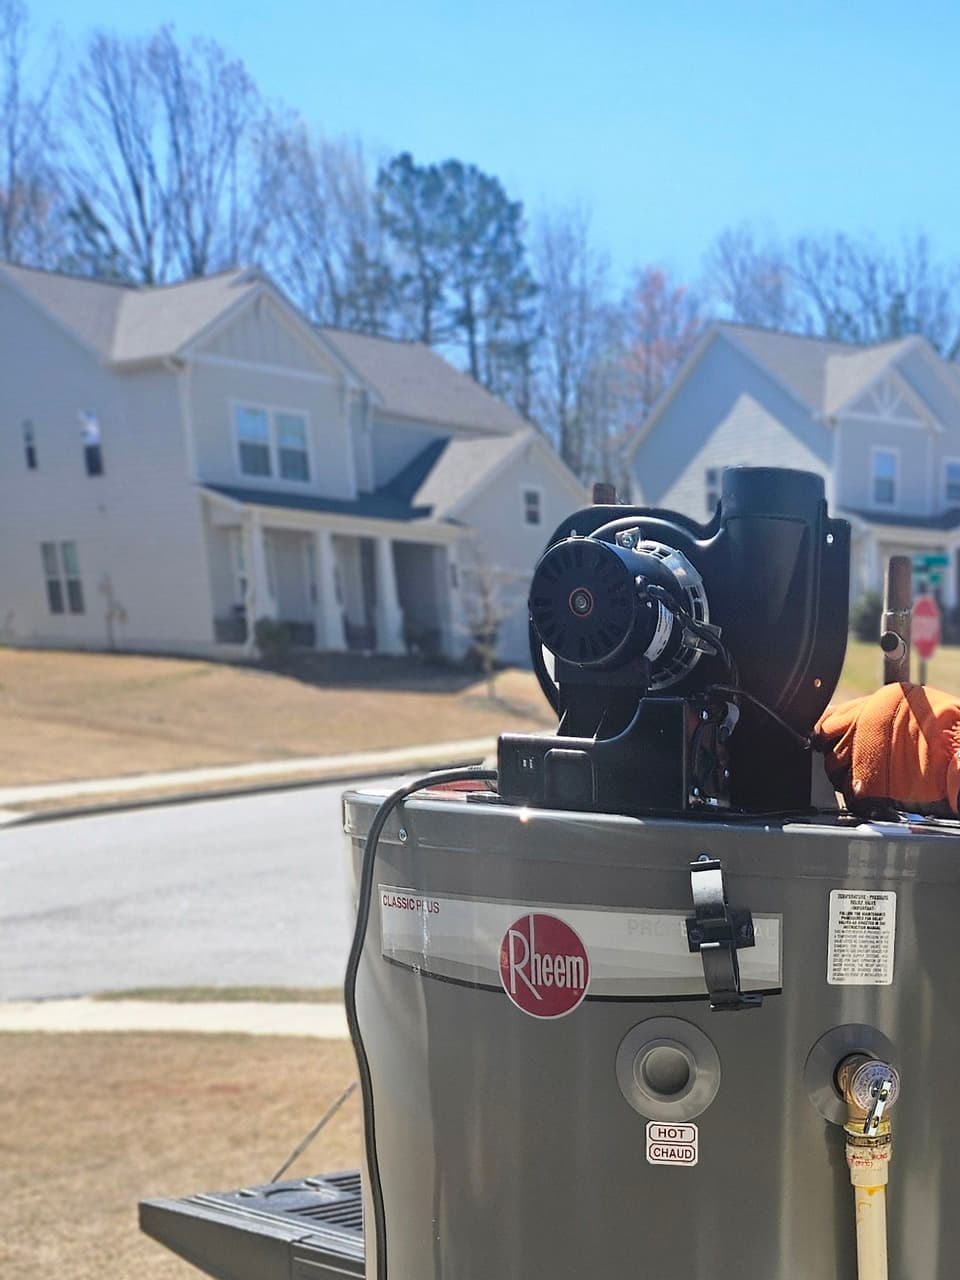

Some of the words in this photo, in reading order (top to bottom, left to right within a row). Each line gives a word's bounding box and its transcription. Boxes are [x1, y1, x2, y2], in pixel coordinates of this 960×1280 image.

[383, 895, 415, 910] CLASSIC
[508, 912, 585, 1000] Rheem
[658, 1128, 686, 1139] HOT
[653, 1147, 693, 1159] CHAUD
